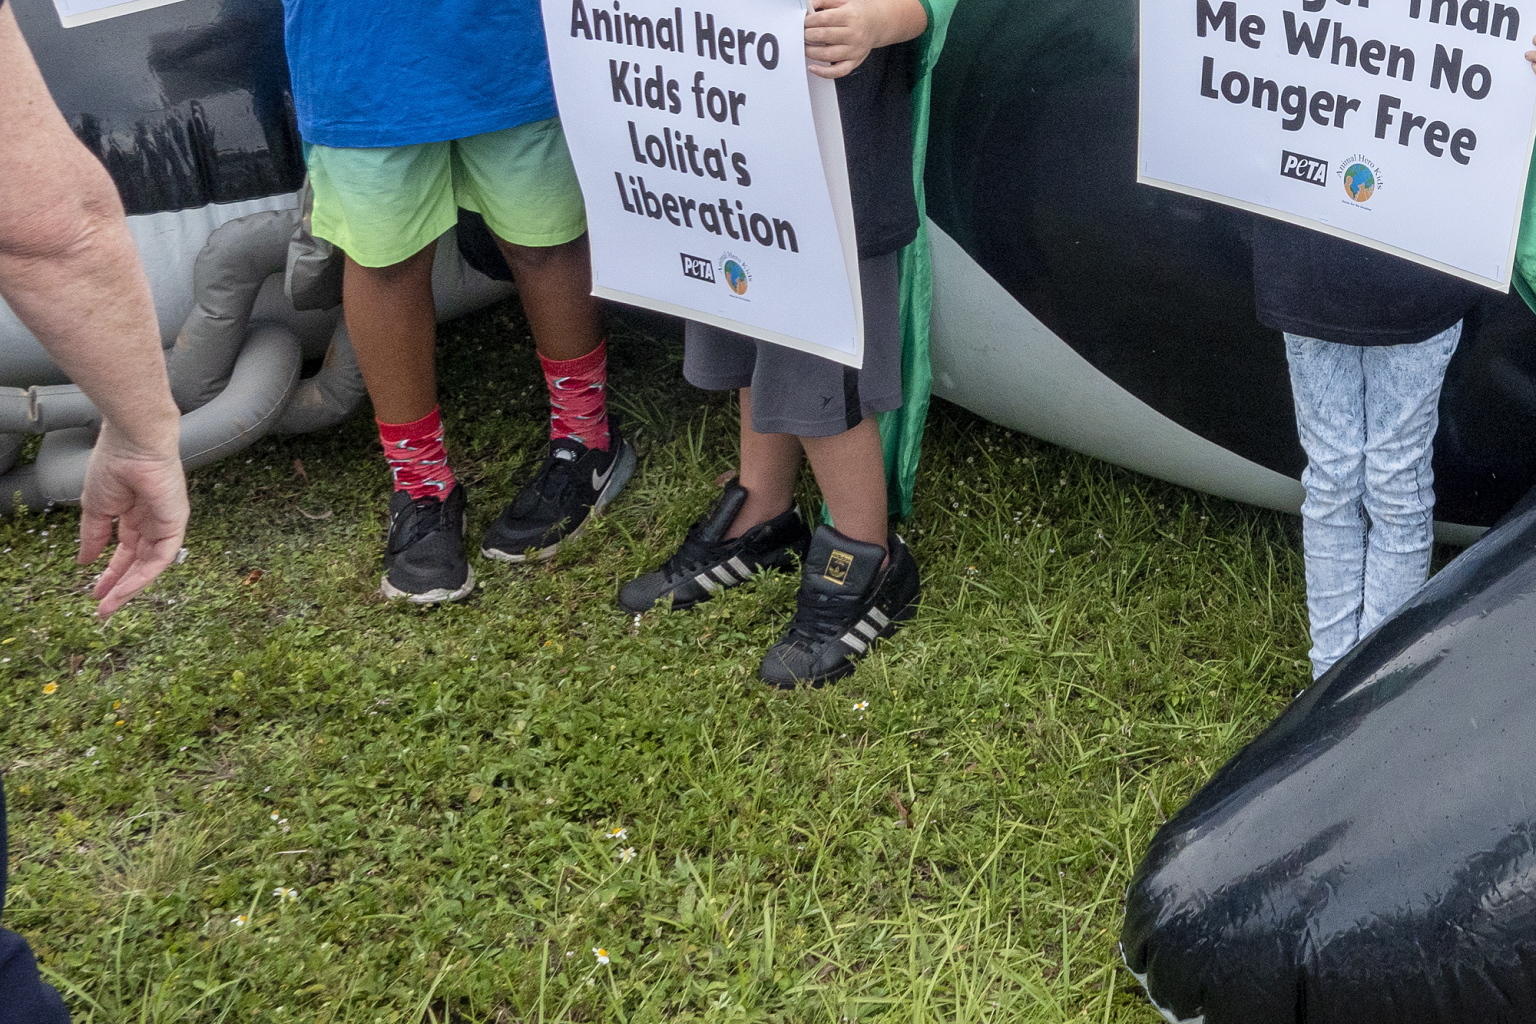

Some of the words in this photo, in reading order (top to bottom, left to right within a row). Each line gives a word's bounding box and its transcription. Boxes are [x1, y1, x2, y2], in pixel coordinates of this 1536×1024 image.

[695, 10, 779, 70] Hero
[1283, 10, 1415, 81] When
[1430, 43, 1492, 100] No
[608, 59, 681, 115] Kids
[691, 71, 746, 126] for
[1200, 56, 1361, 131] Longer
[1375, 94, 1477, 165] Free
[627, 121, 751, 187] Lolita's
[1358, 153, 1375, 168] Hero
[614, 172, 799, 253] Liberation
